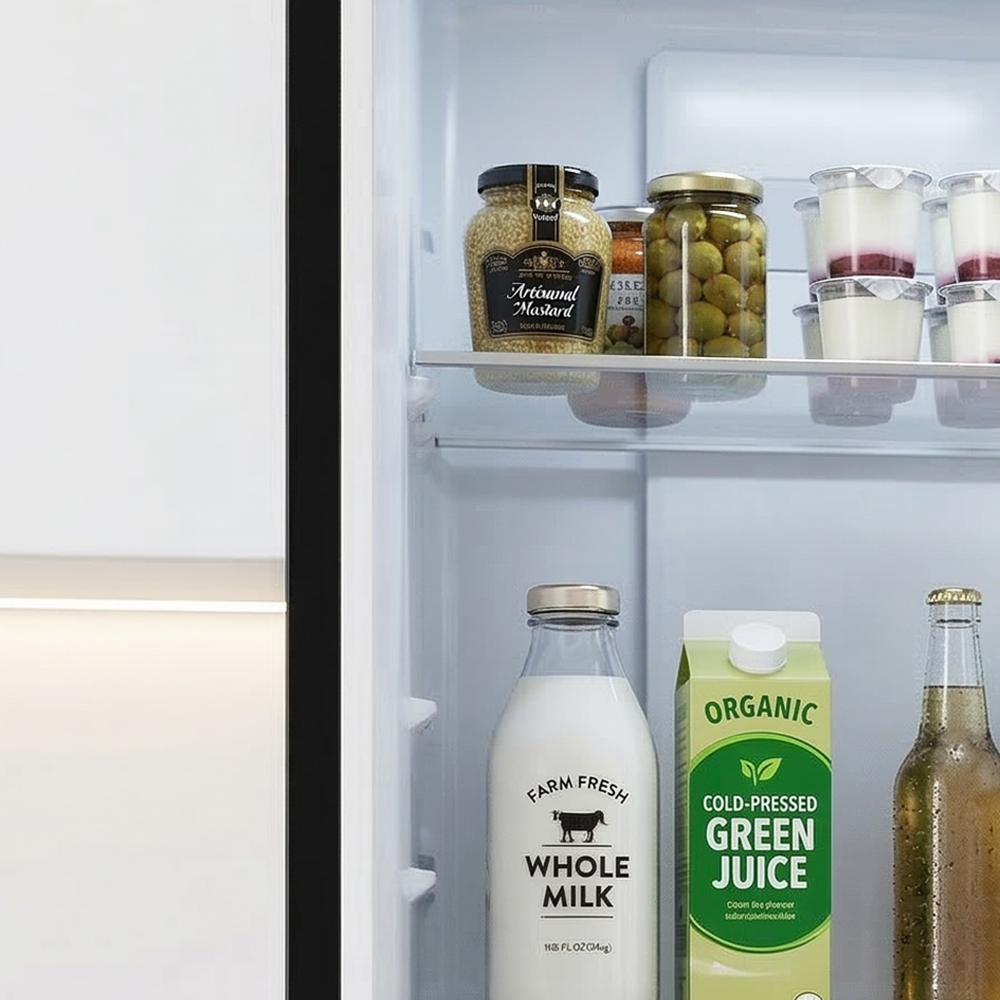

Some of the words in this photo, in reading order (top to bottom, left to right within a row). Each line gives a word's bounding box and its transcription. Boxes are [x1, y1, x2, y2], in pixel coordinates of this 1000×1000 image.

[704, 694, 818, 725] ORGANIC
[526, 774, 573, 803] FARM
[577, 775, 630, 804] FRESH
[702, 794, 818, 812] COLD-PRESSED
[706, 816, 815, 851] GREEN
[525, 855, 630, 878] WHOLE
[711, 855, 808, 890] JUICE
[542, 884, 614, 908] MILK
